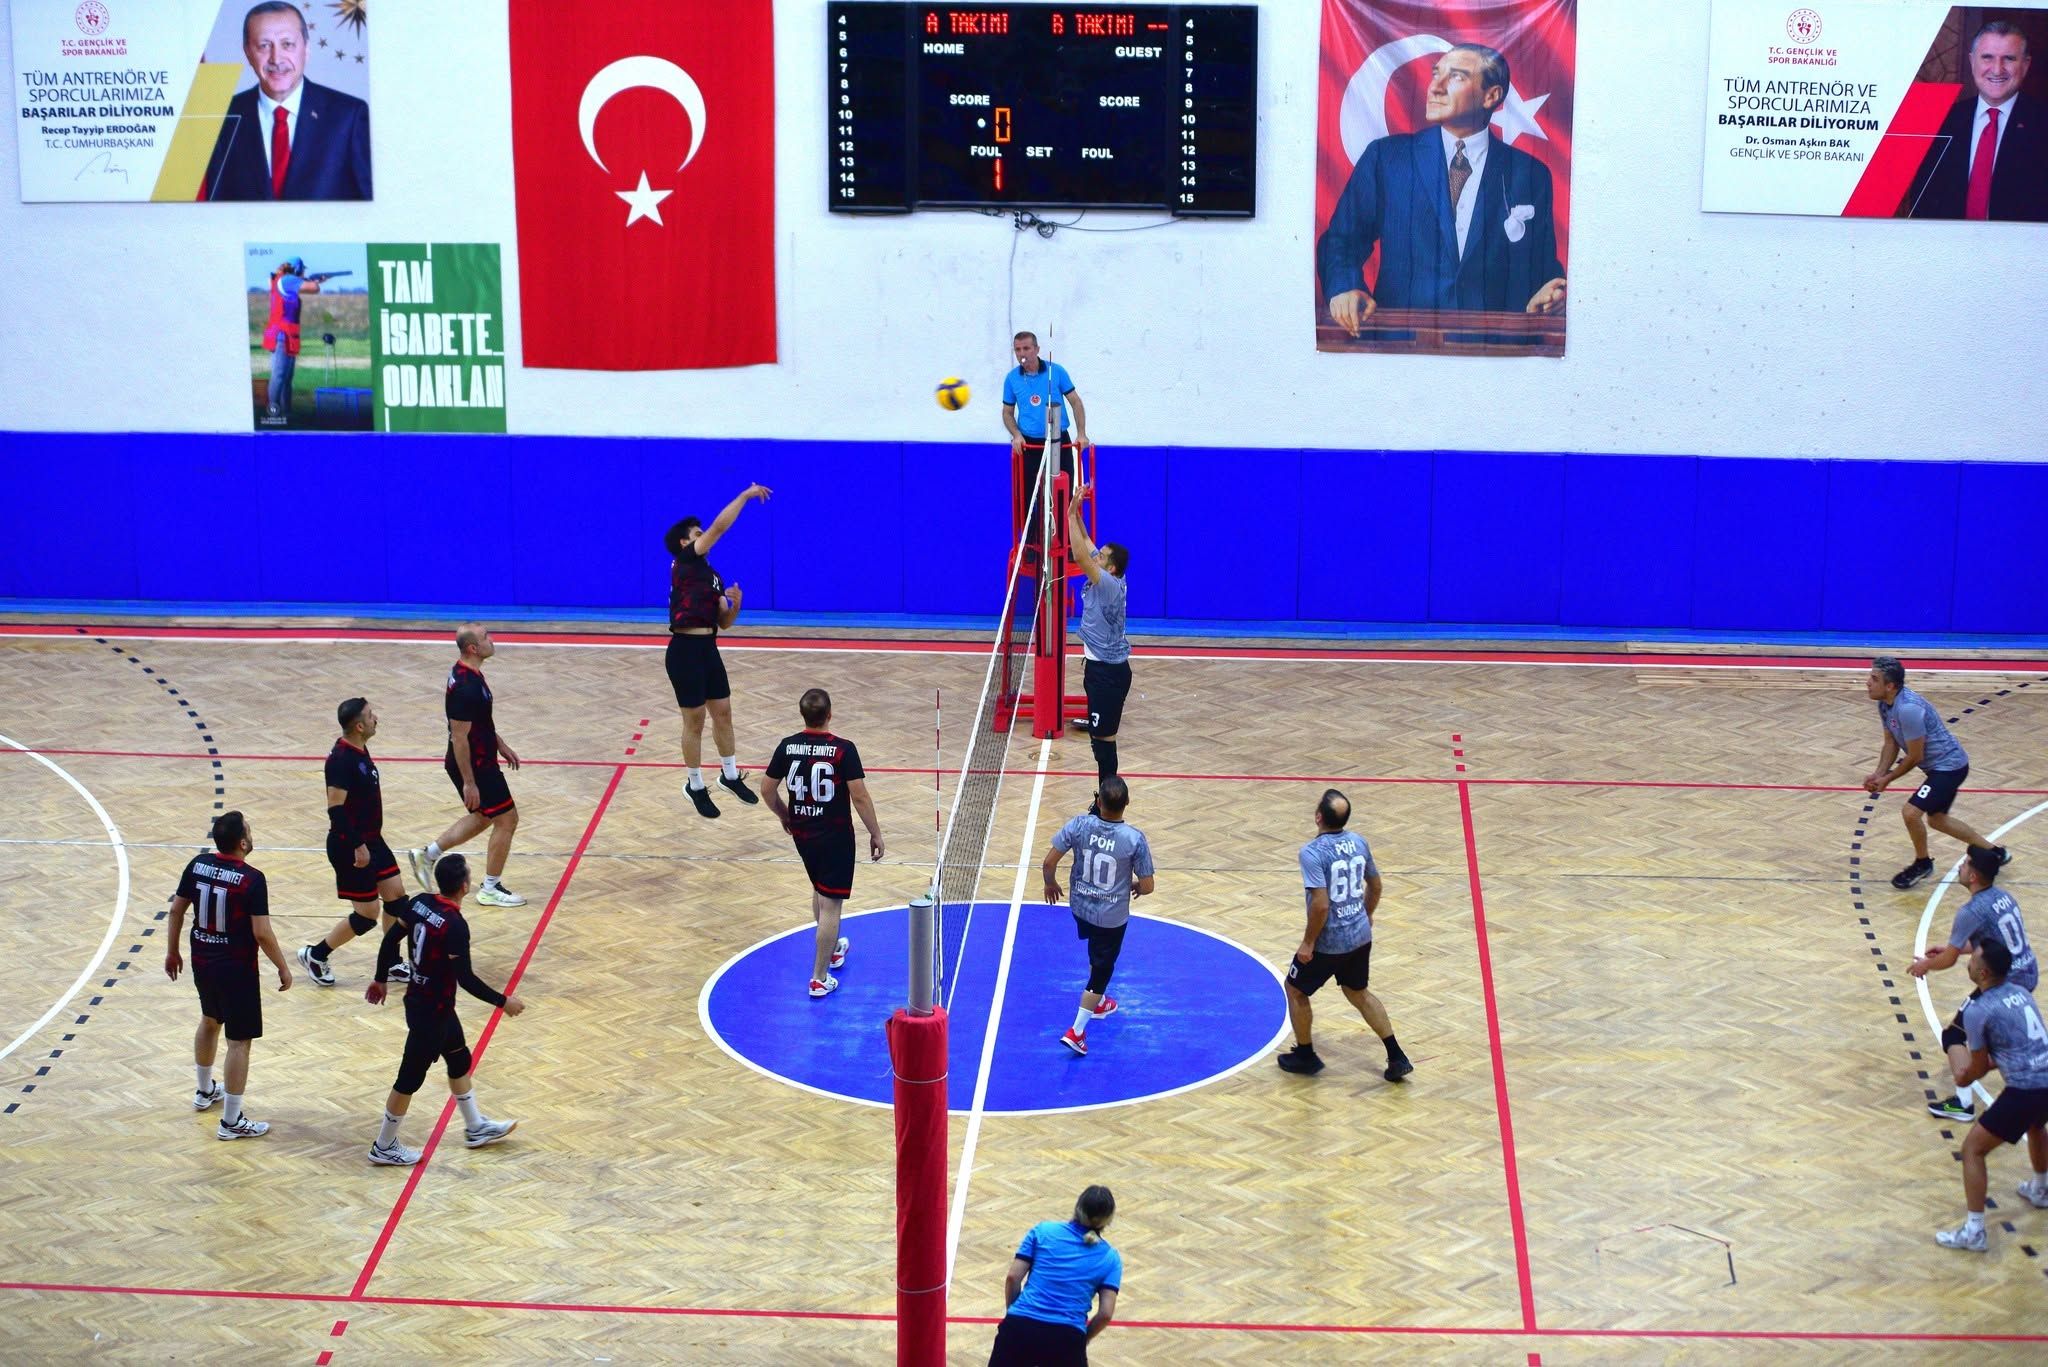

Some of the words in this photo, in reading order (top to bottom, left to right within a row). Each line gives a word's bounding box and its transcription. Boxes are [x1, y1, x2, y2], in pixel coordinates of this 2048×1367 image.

[838, 16, 847, 24] 4
[926, 13, 939, 34] A
[1052, 14, 1064, 35] B
[1186, 19, 1194, 28] 4
[839, 32, 847, 40] 5
[1186, 36, 1193, 45] 5
[78, 38, 112, 48] GENÇLİK
[85, 48, 128, 56] BAKANLIĞI
[839, 48, 848, 57] 6
[924, 43, 964, 54] HOME
[1115, 46, 1162, 58] GUEST
[1786, 47, 1824, 57] GENÇLİK
[1186, 52, 1193, 61] 6
[1792, 57, 1837, 66] BAKANLIĞI
[840, 64, 848, 72] 7
[1186, 68, 1193, 77] 7
[23, 70, 58, 86] TÜM
[62, 68, 147, 86] ANTRENÖR
[149, 71, 168, 85] VE
[840, 79, 848, 88] 8
[1185, 83, 1193, 93] 8
[1724, 76, 1760, 93] TÜM
[1765, 80, 1854, 97] ANTRENÖR
[1858, 84, 1877, 97] VE
[29, 88, 166, 102] SPORCULARIMIZA
[841, 95, 849, 104] 9
[950, 94, 990, 106] SCORE
[1099, 96, 1140, 108] SCORE
[1185, 98, 1193, 108] 9
[1728, 96, 1871, 114] SPORCULARIMIZA
[22, 107, 96, 120] BAŞARILAR
[100, 104, 174, 118] DİLİYORUM
[838, 110, 853, 119] 10
[1182, 115, 1196, 124] 10
[1718, 114, 1797, 128] BAŞARILAR
[1800, 115, 1879, 130] DİLİYORUM
[42, 126, 70, 136] Recep
[72, 125, 104, 136] Tayyip
[106, 124, 156, 134] ERDOĞAN
[996, 108, 1010, 142] 0
[839, 126, 852, 135] 11
[1181, 131, 1195, 140] 11
[46, 139, 62, 148] T.C.
[64, 138, 154, 150] CUMHURBAŞKANI
[839, 141, 854, 150] 12
[1746, 136, 1760, 144] Dr.
[1762, 137, 1796, 146] Osman
[1800, 138, 1827, 148] Aşkın
[1829, 139, 1850, 148] BAK
[970, 146, 1002, 156] FOUL
[1026, 146, 1053, 158] SET
[1082, 148, 1114, 159] FOUL
[1181, 146, 1195, 155] 12
[1730, 147, 1775, 160] GENÇLİK
[1777, 150, 1791, 159] VE
[1793, 150, 1821, 160] SPOR
[1824, 151, 1864, 162] BAKANI
[840, 157, 854, 167] 13
[1181, 161, 1196, 170] 13
[840, 173, 854, 182] 14
[1181, 177, 1196, 186] 14
[840, 188, 854, 197] 15
[1180, 194, 1194, 203] 15
[378, 260, 434, 304] TAM
[382, 364, 504, 408] ODAKLAN
[1091, 712, 1100, 727] 3
[786, 760, 836, 803] 46
[1917, 784, 1932, 799] 8
[1089, 834, 1116, 852] PÖH
[1336, 840, 1356, 856] PÖH
[1082, 849, 1118, 890] 10
[1330, 855, 1366, 903] 60
[196, 880, 228, 932] 11
[413, 922, 426, 966] 9
[2024, 1005, 2048, 1045] 4
